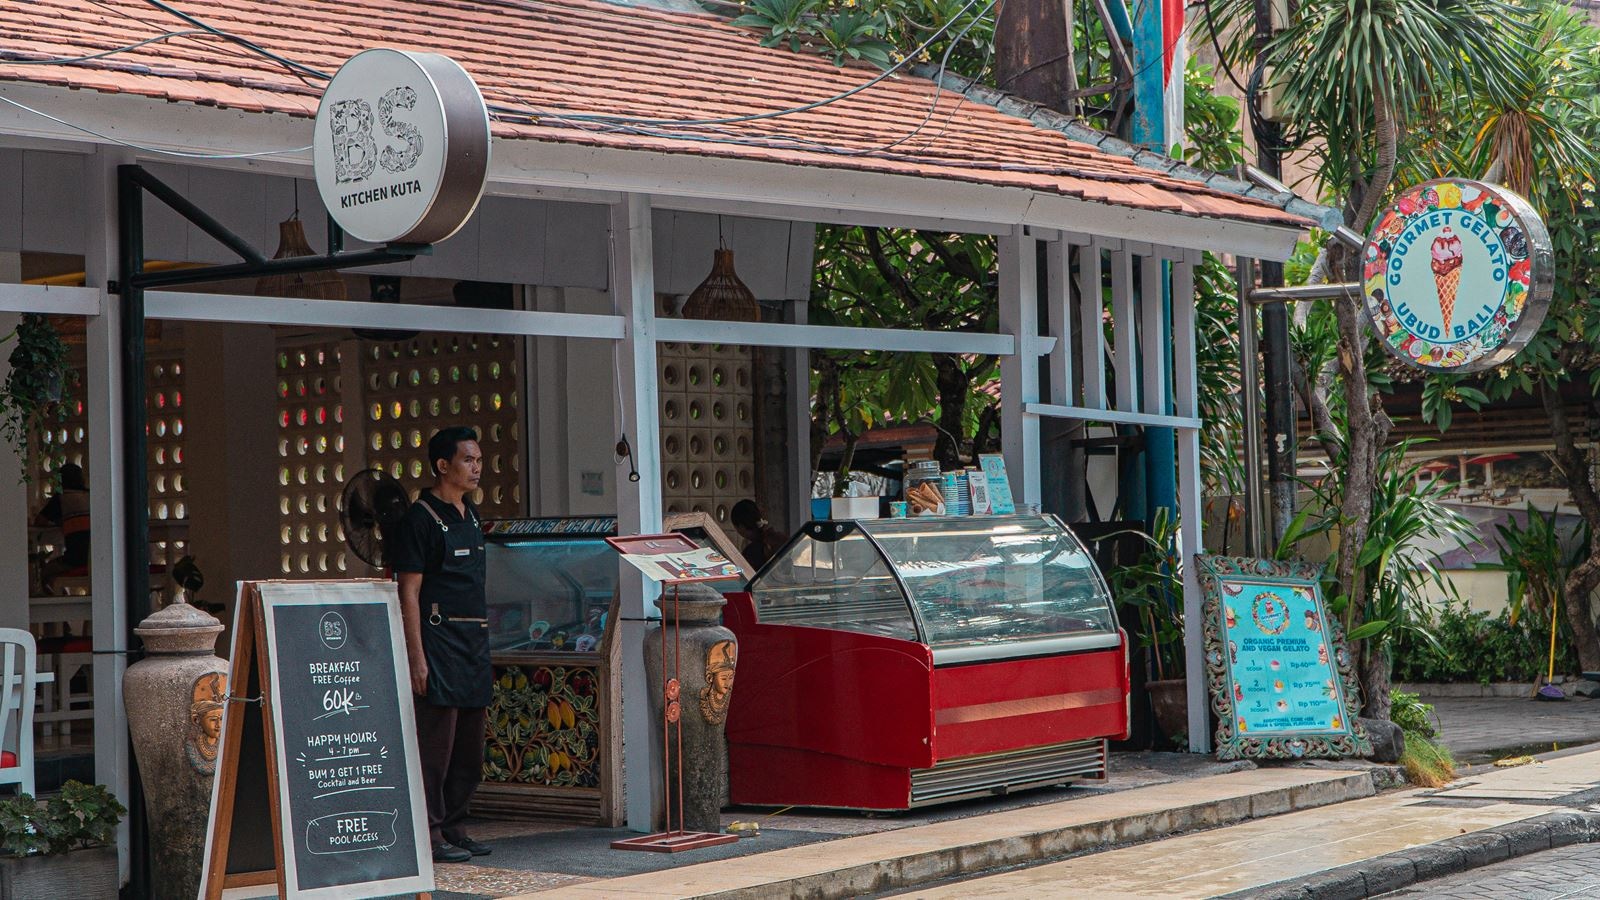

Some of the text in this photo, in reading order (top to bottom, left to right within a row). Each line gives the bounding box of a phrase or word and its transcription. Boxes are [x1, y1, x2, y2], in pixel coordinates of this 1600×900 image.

[340, 179, 422, 209] KITCHEN KUTA
[1389, 212, 1505, 287] GOURMET GELATO
[1397, 302, 1494, 340] UBUD BALI
[309, 661, 361, 674] BREAKFAST
[312, 674, 360, 685] FREE Coffee
[1253, 679, 1259, 687] 2
[323, 688, 354, 715] 60K
[1256, 700, 1261, 708] 3
[307, 731, 378, 747] HAPPY HOURS
[342, 746, 346, 754] 7
[348, 747, 360, 756] pm
[309, 764, 383, 780] BUY 2 GET 1 FREE
[317, 776, 376, 788] Cocktail and Beer
[336, 817, 369, 834] FREE
[329, 832, 379, 845] POOL ACCESS
